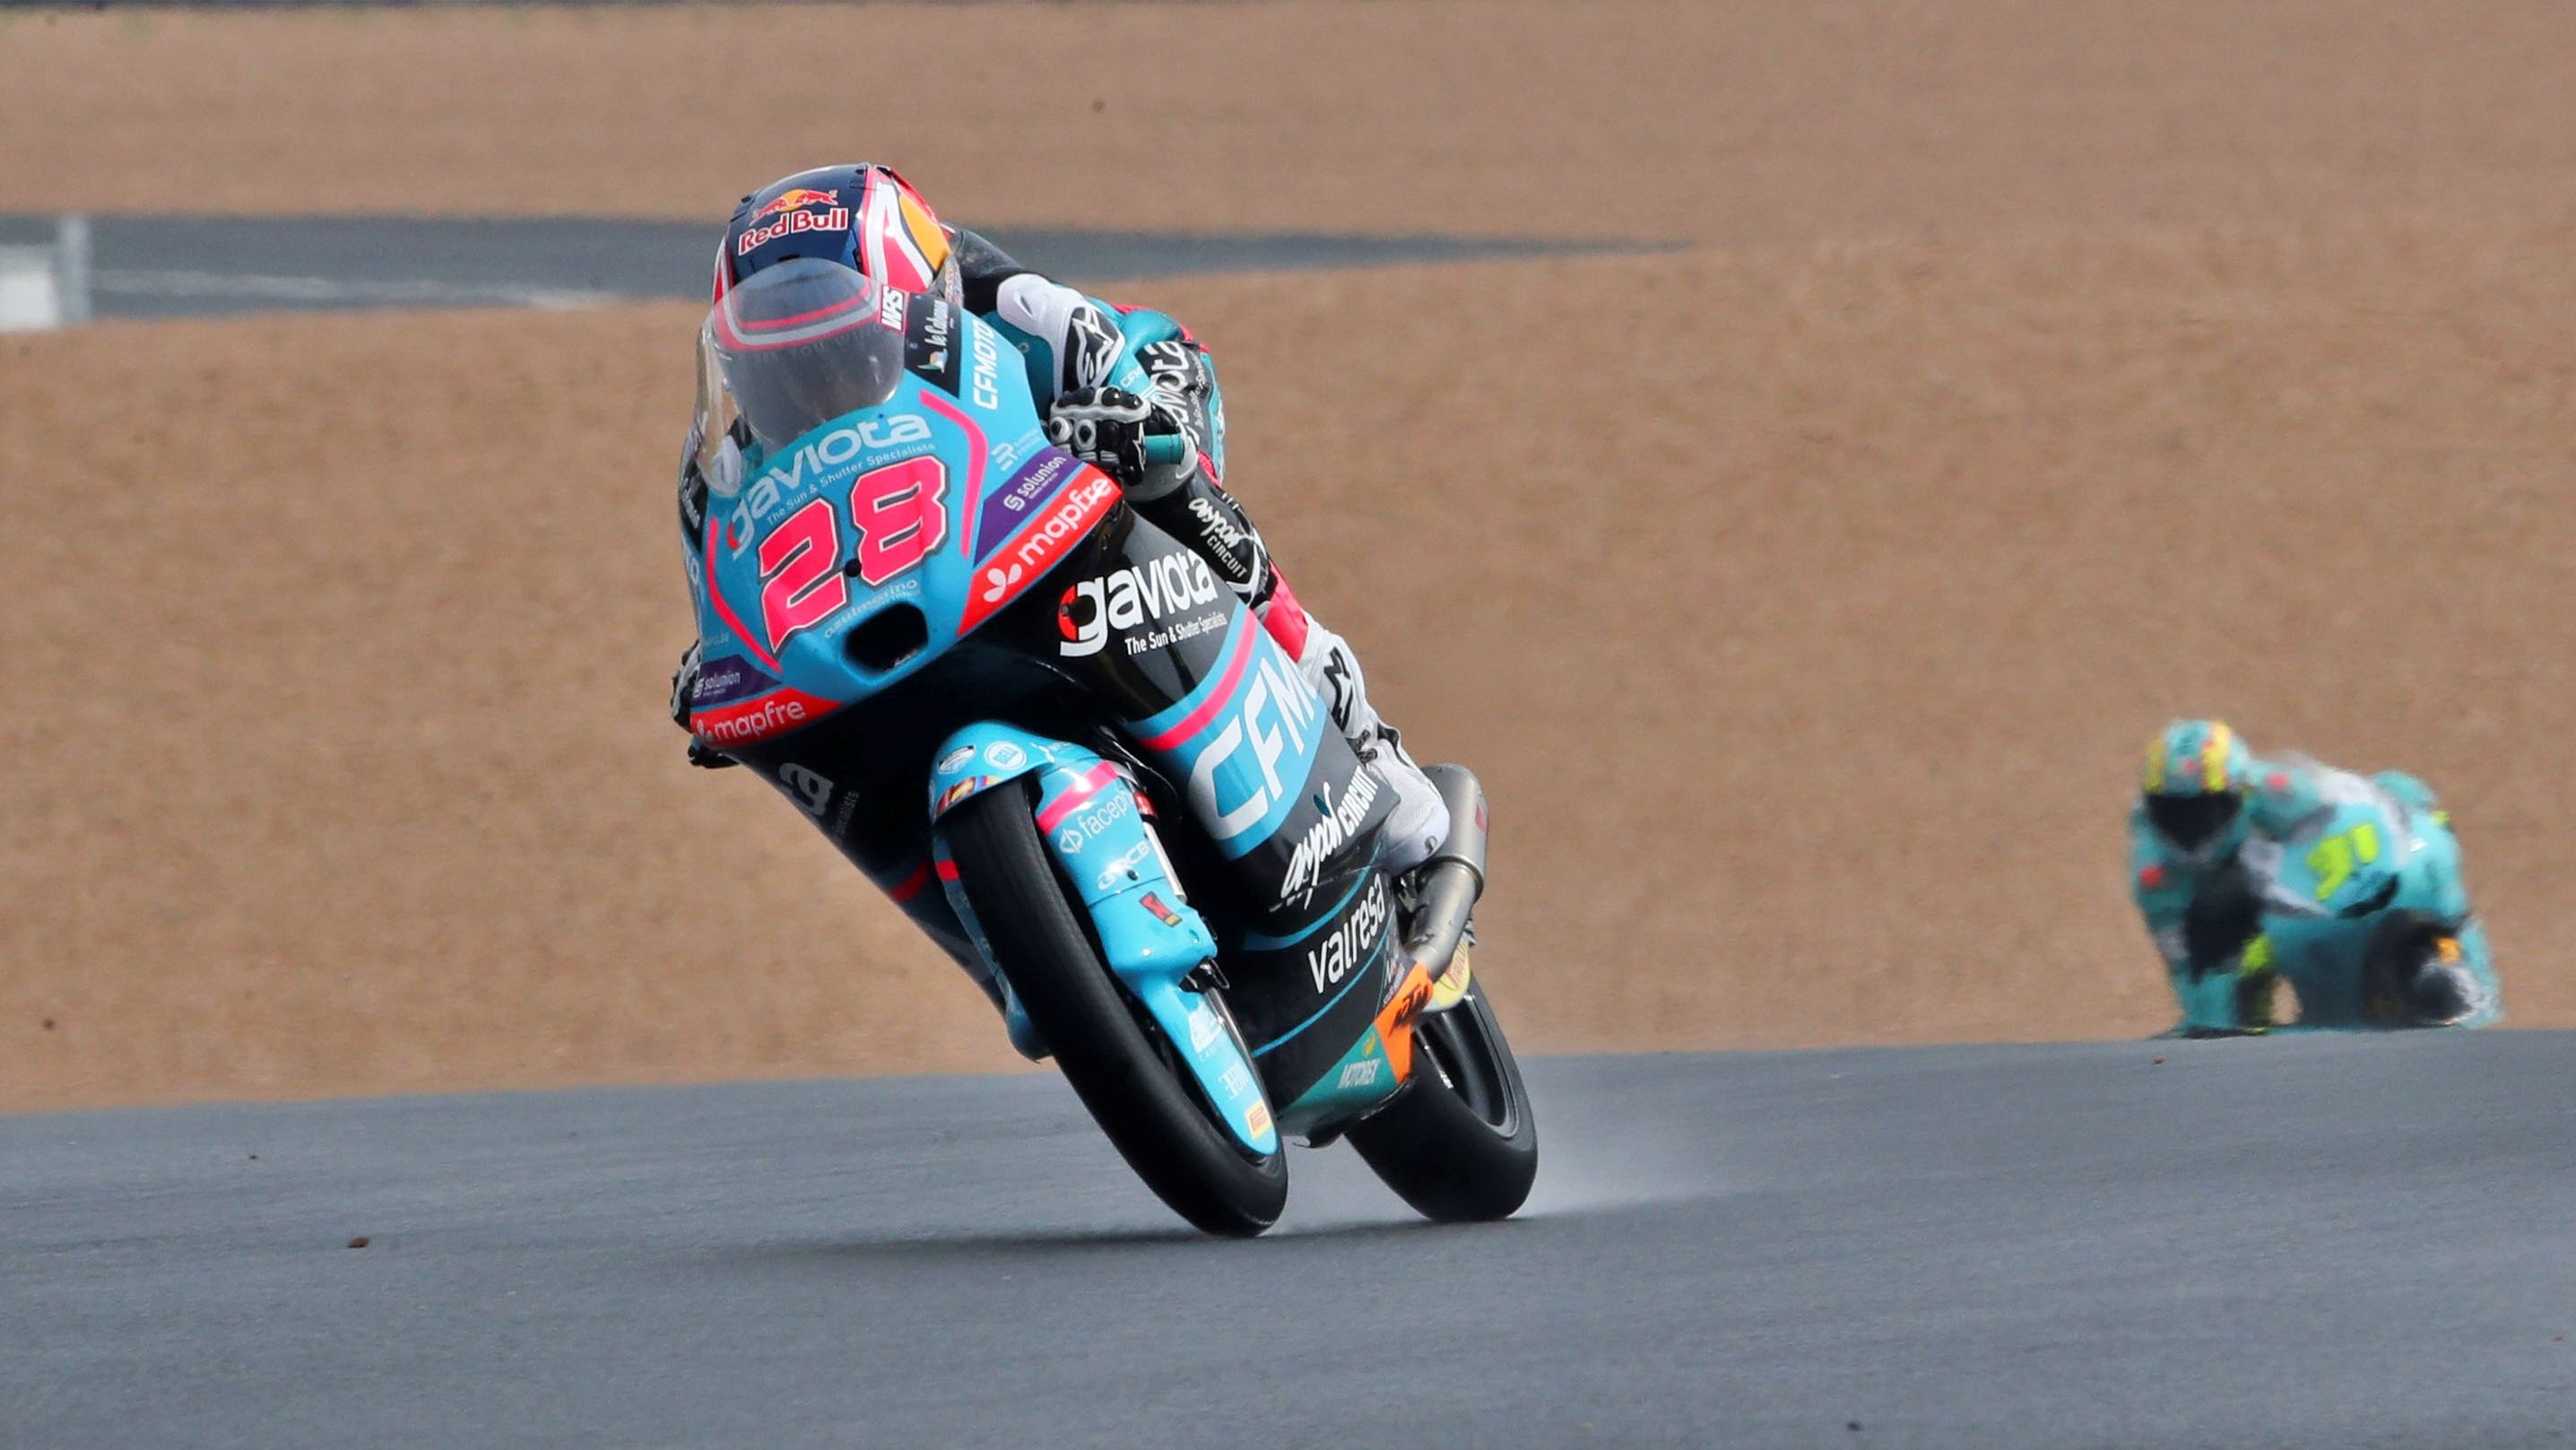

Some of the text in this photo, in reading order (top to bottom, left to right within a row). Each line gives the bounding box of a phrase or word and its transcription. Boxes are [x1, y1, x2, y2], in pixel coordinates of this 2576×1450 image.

[739, 208, 849, 256] Red Bull
[972, 318, 998, 411] CFMOTO
[727, 413, 932, 562] gaviota
[767, 442, 936, 526] The Sun & Shutter Specialists
[1017, 456, 1067, 497] solunion
[759, 456, 946, 654] 28
[1019, 478, 1112, 566] mapfre
[1207, 537, 1248, 578] CIRCUIT
[824, 578, 918, 638] azulmarino
[1059, 548, 1219, 657] gaviota
[1124, 611, 1227, 656] The Sun & Shutter Specialists
[704, 672, 741, 691] solunion
[714, 700, 805, 741] mapfre
[1188, 630, 1316, 841] CFM
[1345, 764, 1378, 837] CIRCUIT
[1307, 873, 1386, 994] valresa
